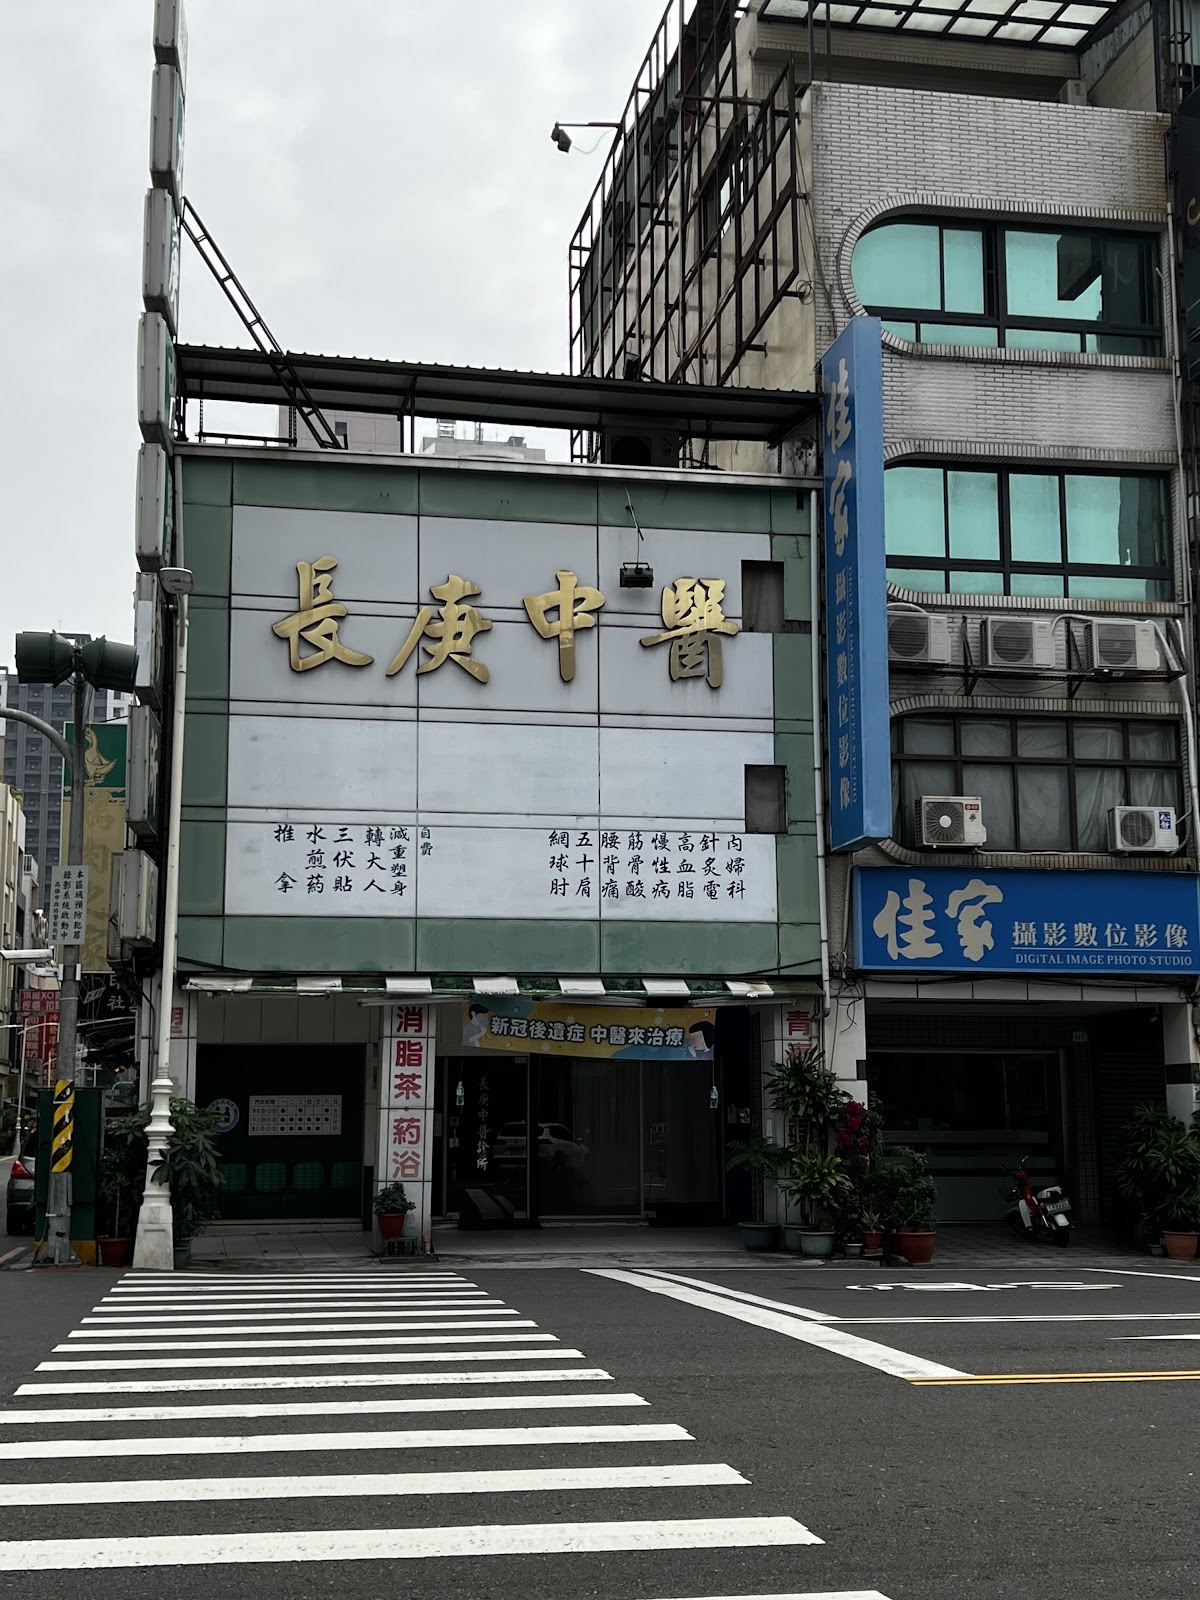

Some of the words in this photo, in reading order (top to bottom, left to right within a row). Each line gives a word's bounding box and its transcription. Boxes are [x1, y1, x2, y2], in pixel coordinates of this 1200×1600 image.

[272, 556, 740, 688] 長庚中醫
[274, 824, 297, 893] 推拿
[333, 826, 356, 892] 三伏貼
[364, 826, 386, 892] 轉大人
[389, 826, 410, 896] 減重塑身
[549, 831, 569, 897] 網球肘
[575, 832, 594, 898] 五十肩
[601, 832, 621, 899] 腰背痛
[626, 831, 646, 899] 筋骨酸
[652, 832, 671, 899] 慢性病
[677, 832, 696, 899] 高血脂
[700, 833, 721, 900] 針灸電
[73, 869, 84, 940] 本區域預防犯罪
[873, 879, 1003, 962] 佳家
[1012, 921, 1188, 948] 攝影數位影像
[1066, 954, 1104, 965] IMAGE
[1107, 954, 1147, 966] PHOTO
[1149, 955, 1192, 966] STUDIO
[490, 1016, 585, 1043] 新冠後遺症
[590, 1021, 685, 1047] 中醫來治療
